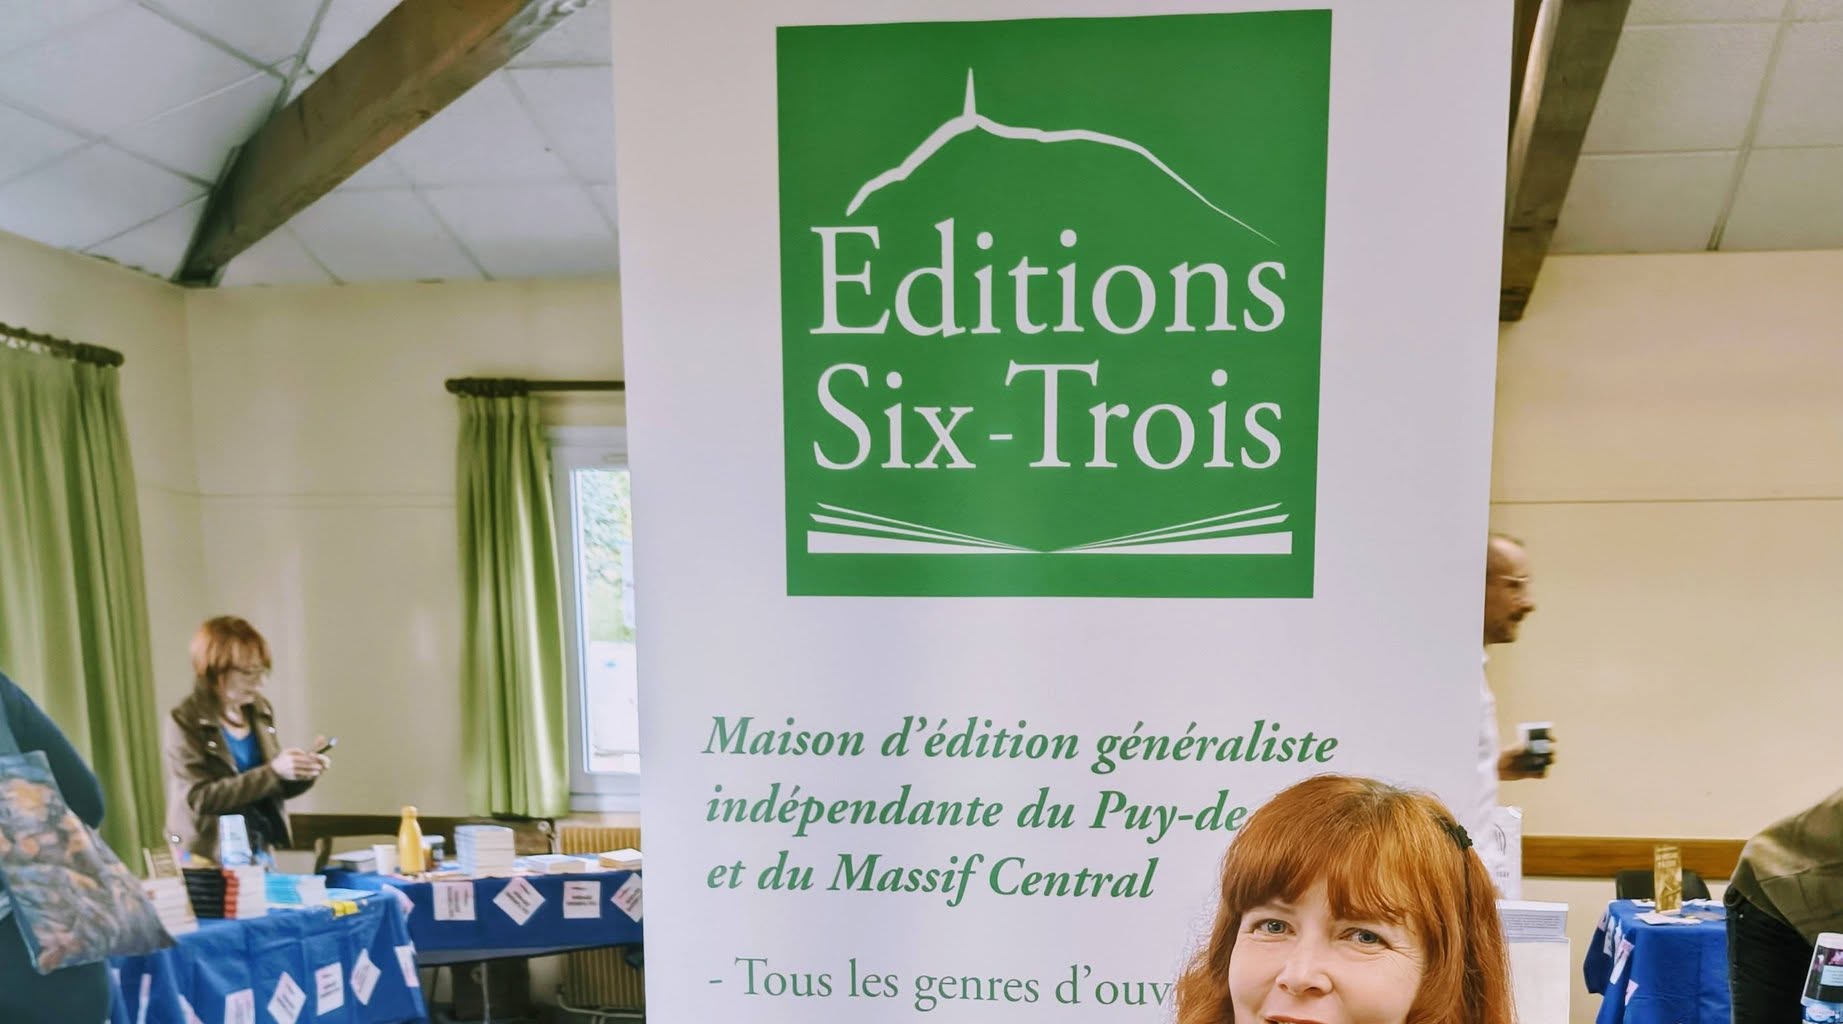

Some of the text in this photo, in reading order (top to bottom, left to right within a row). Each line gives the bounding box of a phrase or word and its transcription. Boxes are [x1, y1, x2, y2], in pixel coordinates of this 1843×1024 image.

[813, 359, 1283, 470] Six-Trois
[702, 716, 1339, 775] Maison d'édition généraliste
[706, 783, 1247, 845] indépendante du Puy-de
[707, 851, 1160, 907] et du Massif Central
[734, 957, 1173, 1012] Tous les genres d'ouv
